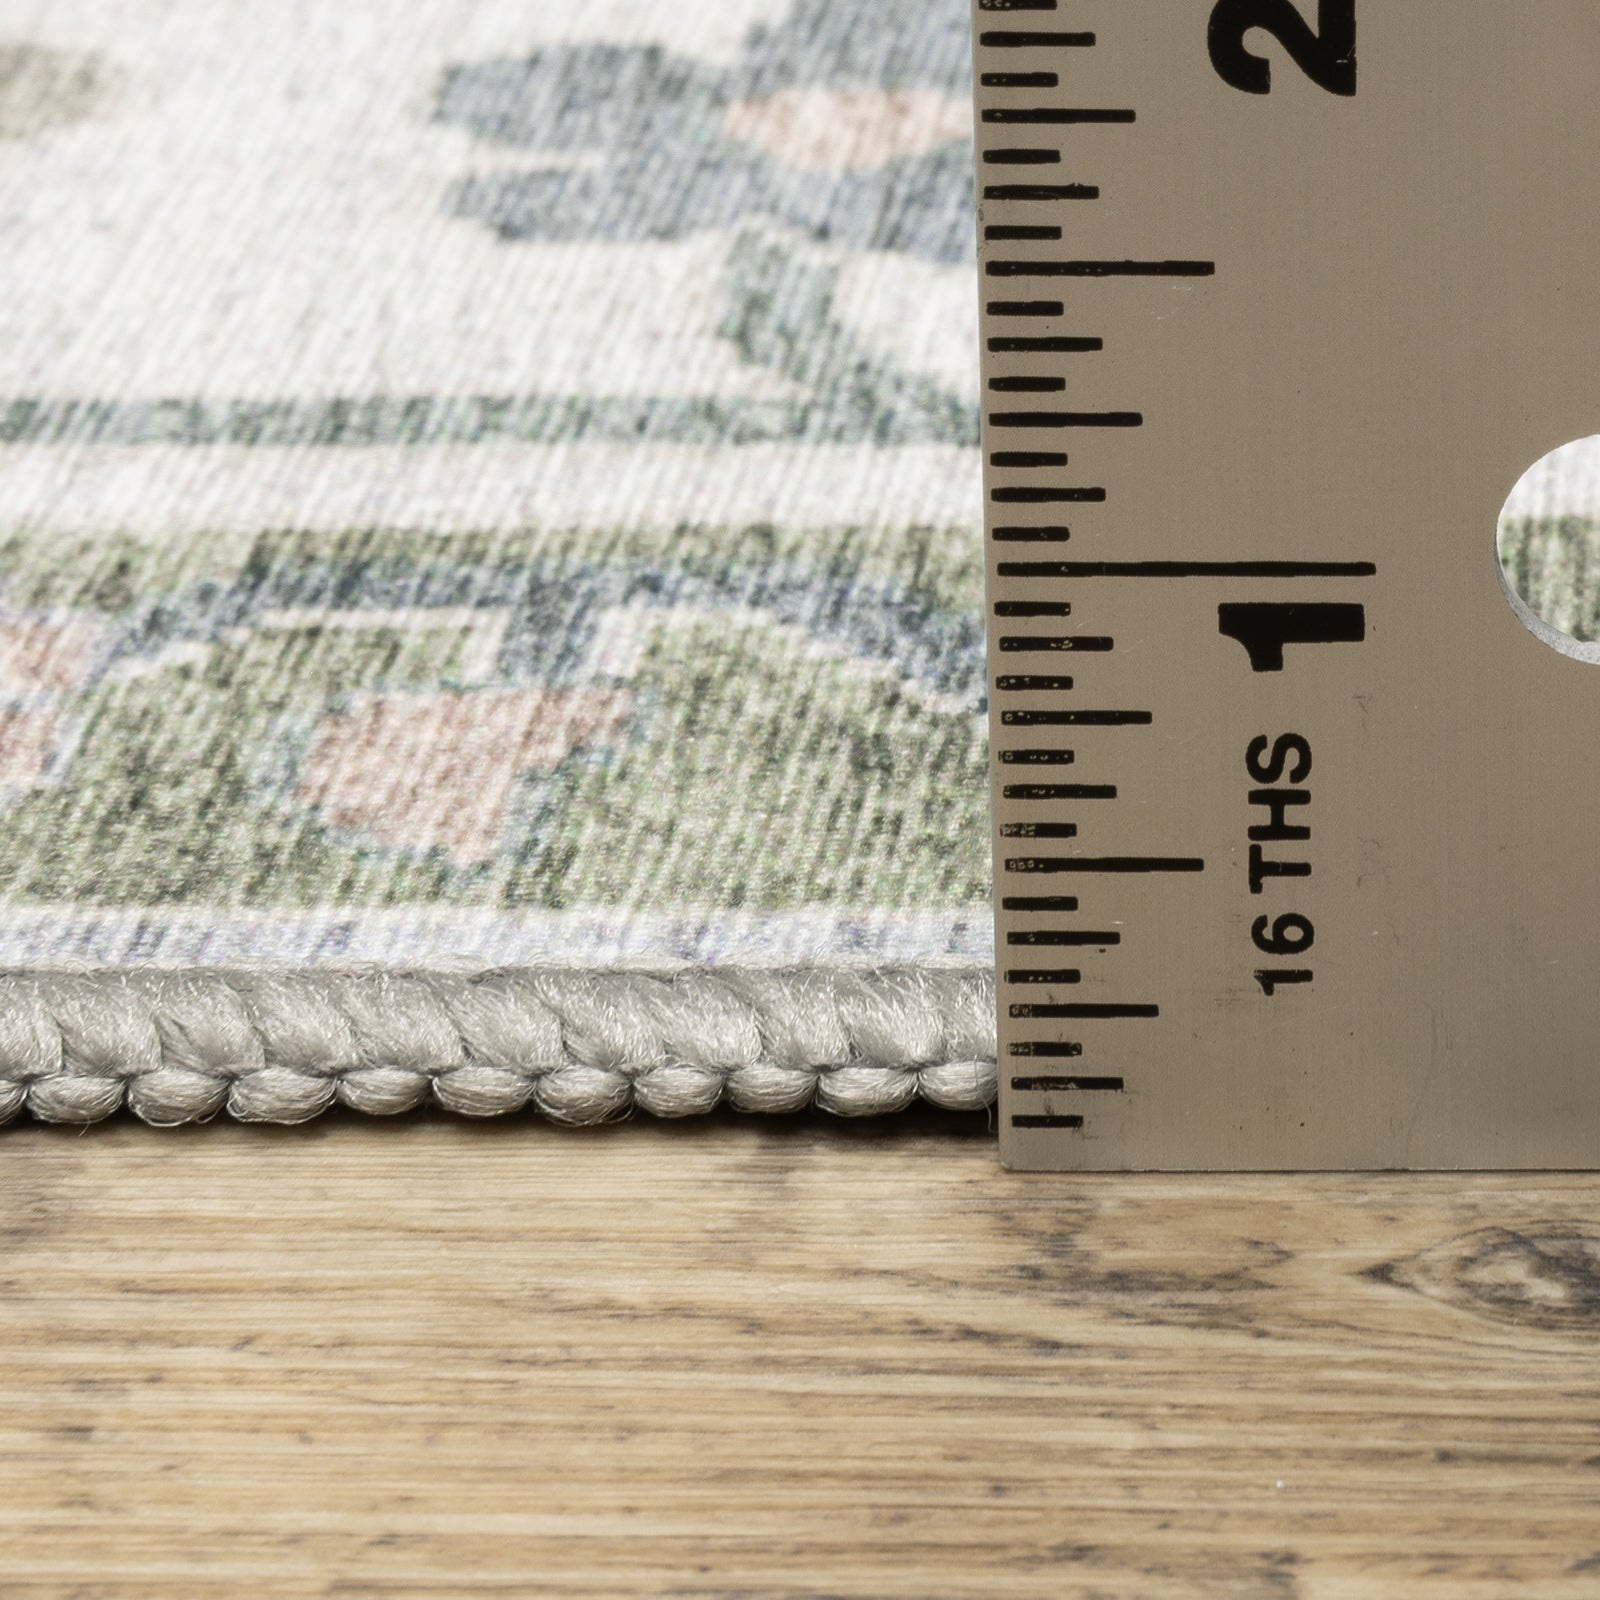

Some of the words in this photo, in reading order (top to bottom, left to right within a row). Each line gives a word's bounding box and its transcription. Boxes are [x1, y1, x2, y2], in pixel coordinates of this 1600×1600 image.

[1218, 602, 1365, 672] 1
[1246, 733, 1312, 894] THS
[1252, 913, 1314, 997] 16
